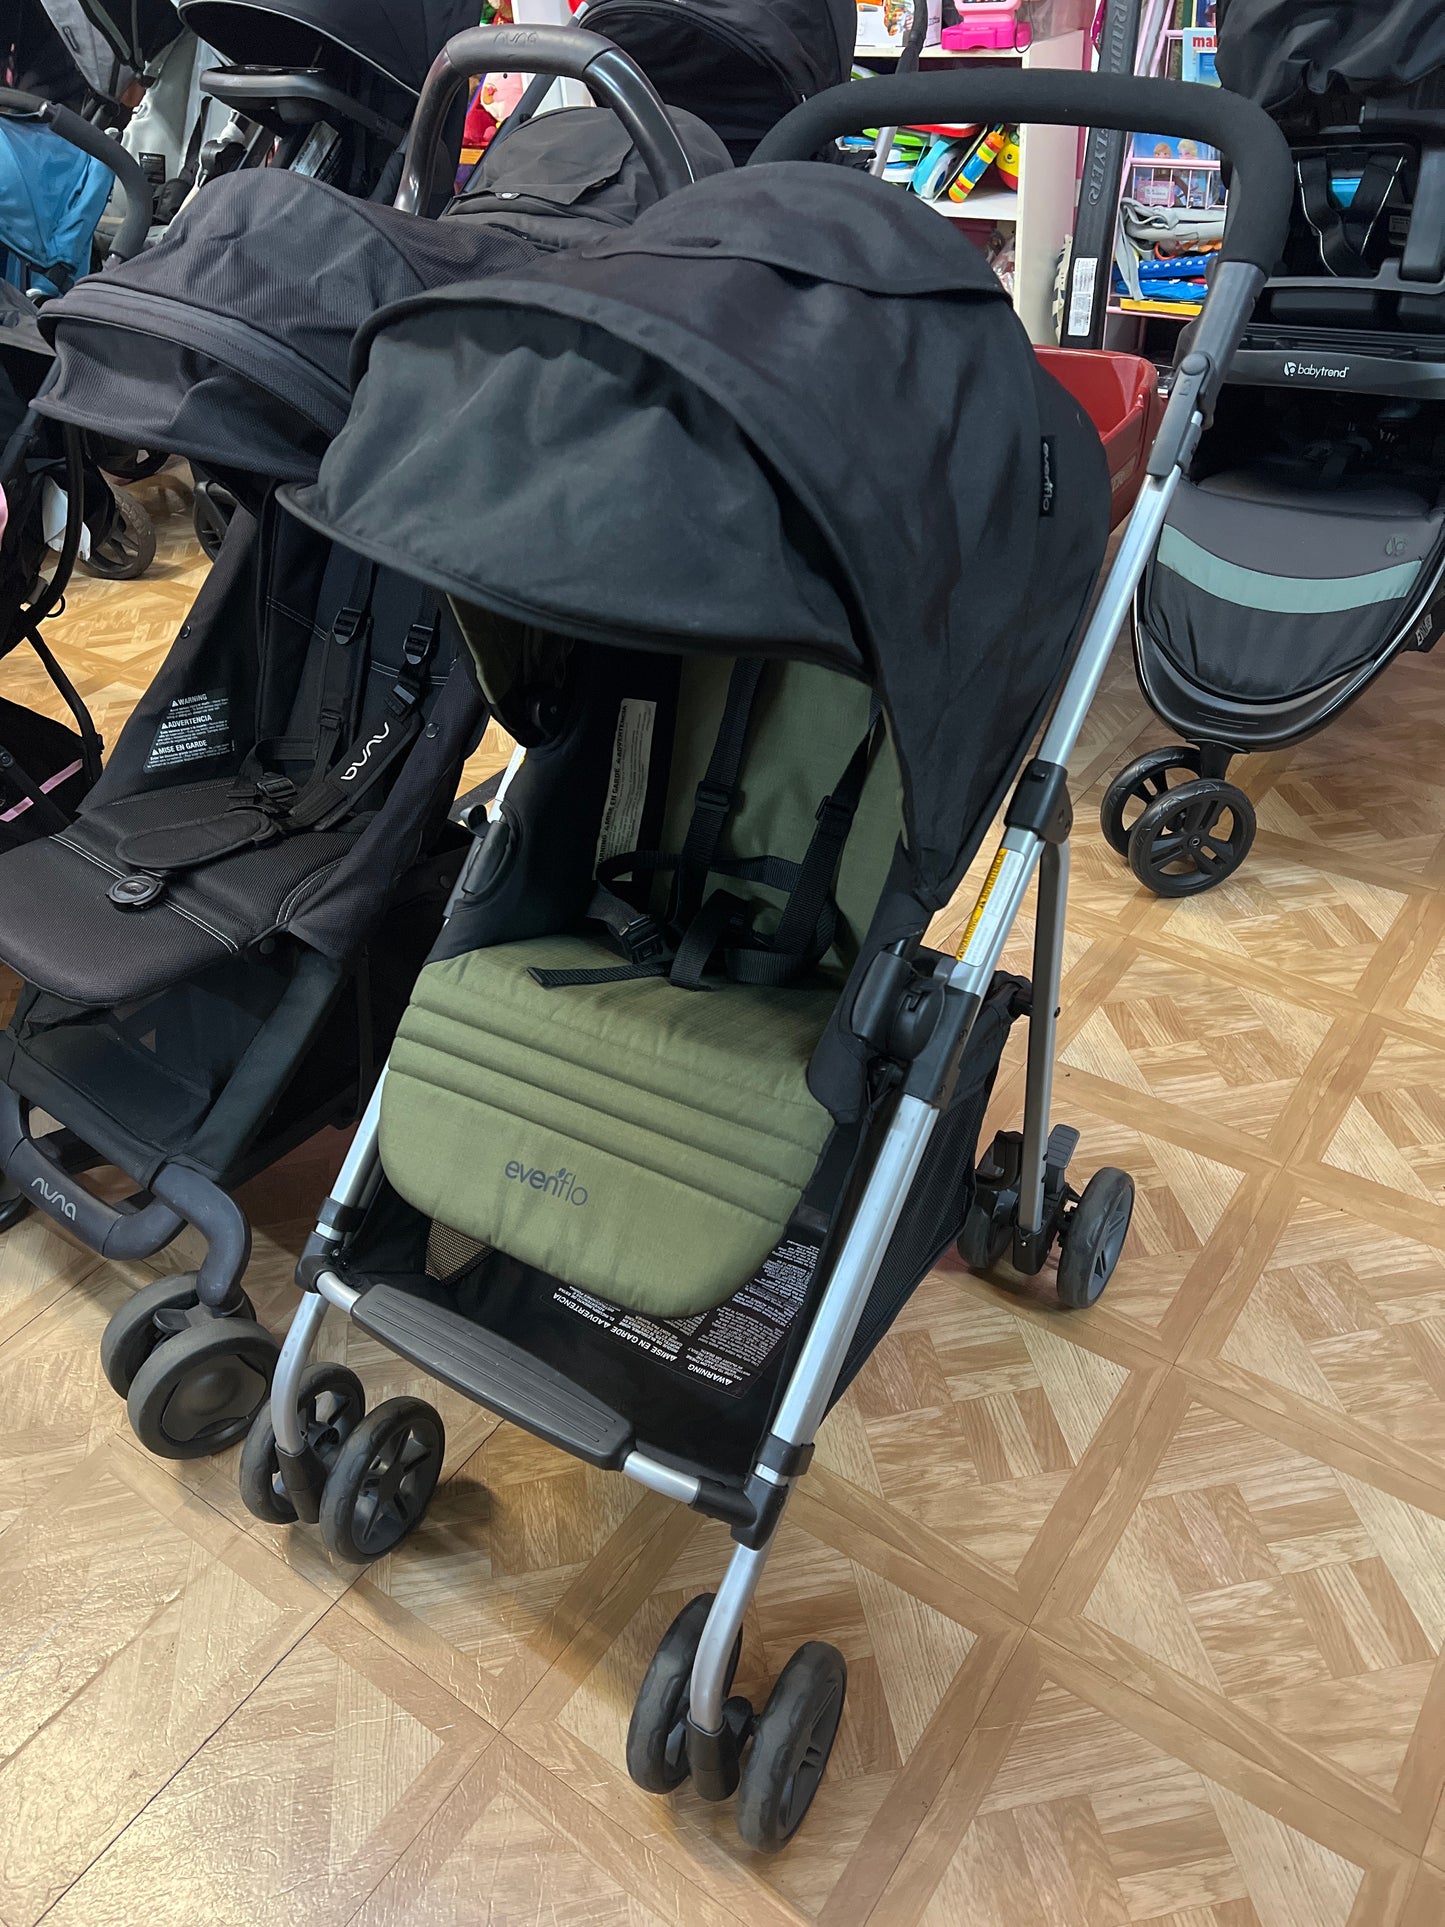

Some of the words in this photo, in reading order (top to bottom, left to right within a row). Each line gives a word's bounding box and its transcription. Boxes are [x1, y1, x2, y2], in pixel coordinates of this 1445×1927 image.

[1297, 363, 1347, 379] babytrend
[1042, 442, 1053, 511] evenflo
[178, 693, 208, 705] WARNING
[168, 714, 213, 728] ADVERTENCIA
[158, 746, 175, 755] MISE
[175, 744, 185, 752] EN
[185, 740, 208, 750] GARDE
[340, 721, 390, 781] nuna
[505, 1160, 588, 1206] evenflo
[31, 1177, 76, 1221] nuna
[553, 1292, 604, 1325] ADVERTENCIA
[610, 1325, 639, 1343] GARDE
[637, 1339, 651, 1350] EN
[650, 1346, 671, 1360] MISE
[687, 1363, 726, 1383] WARNING
